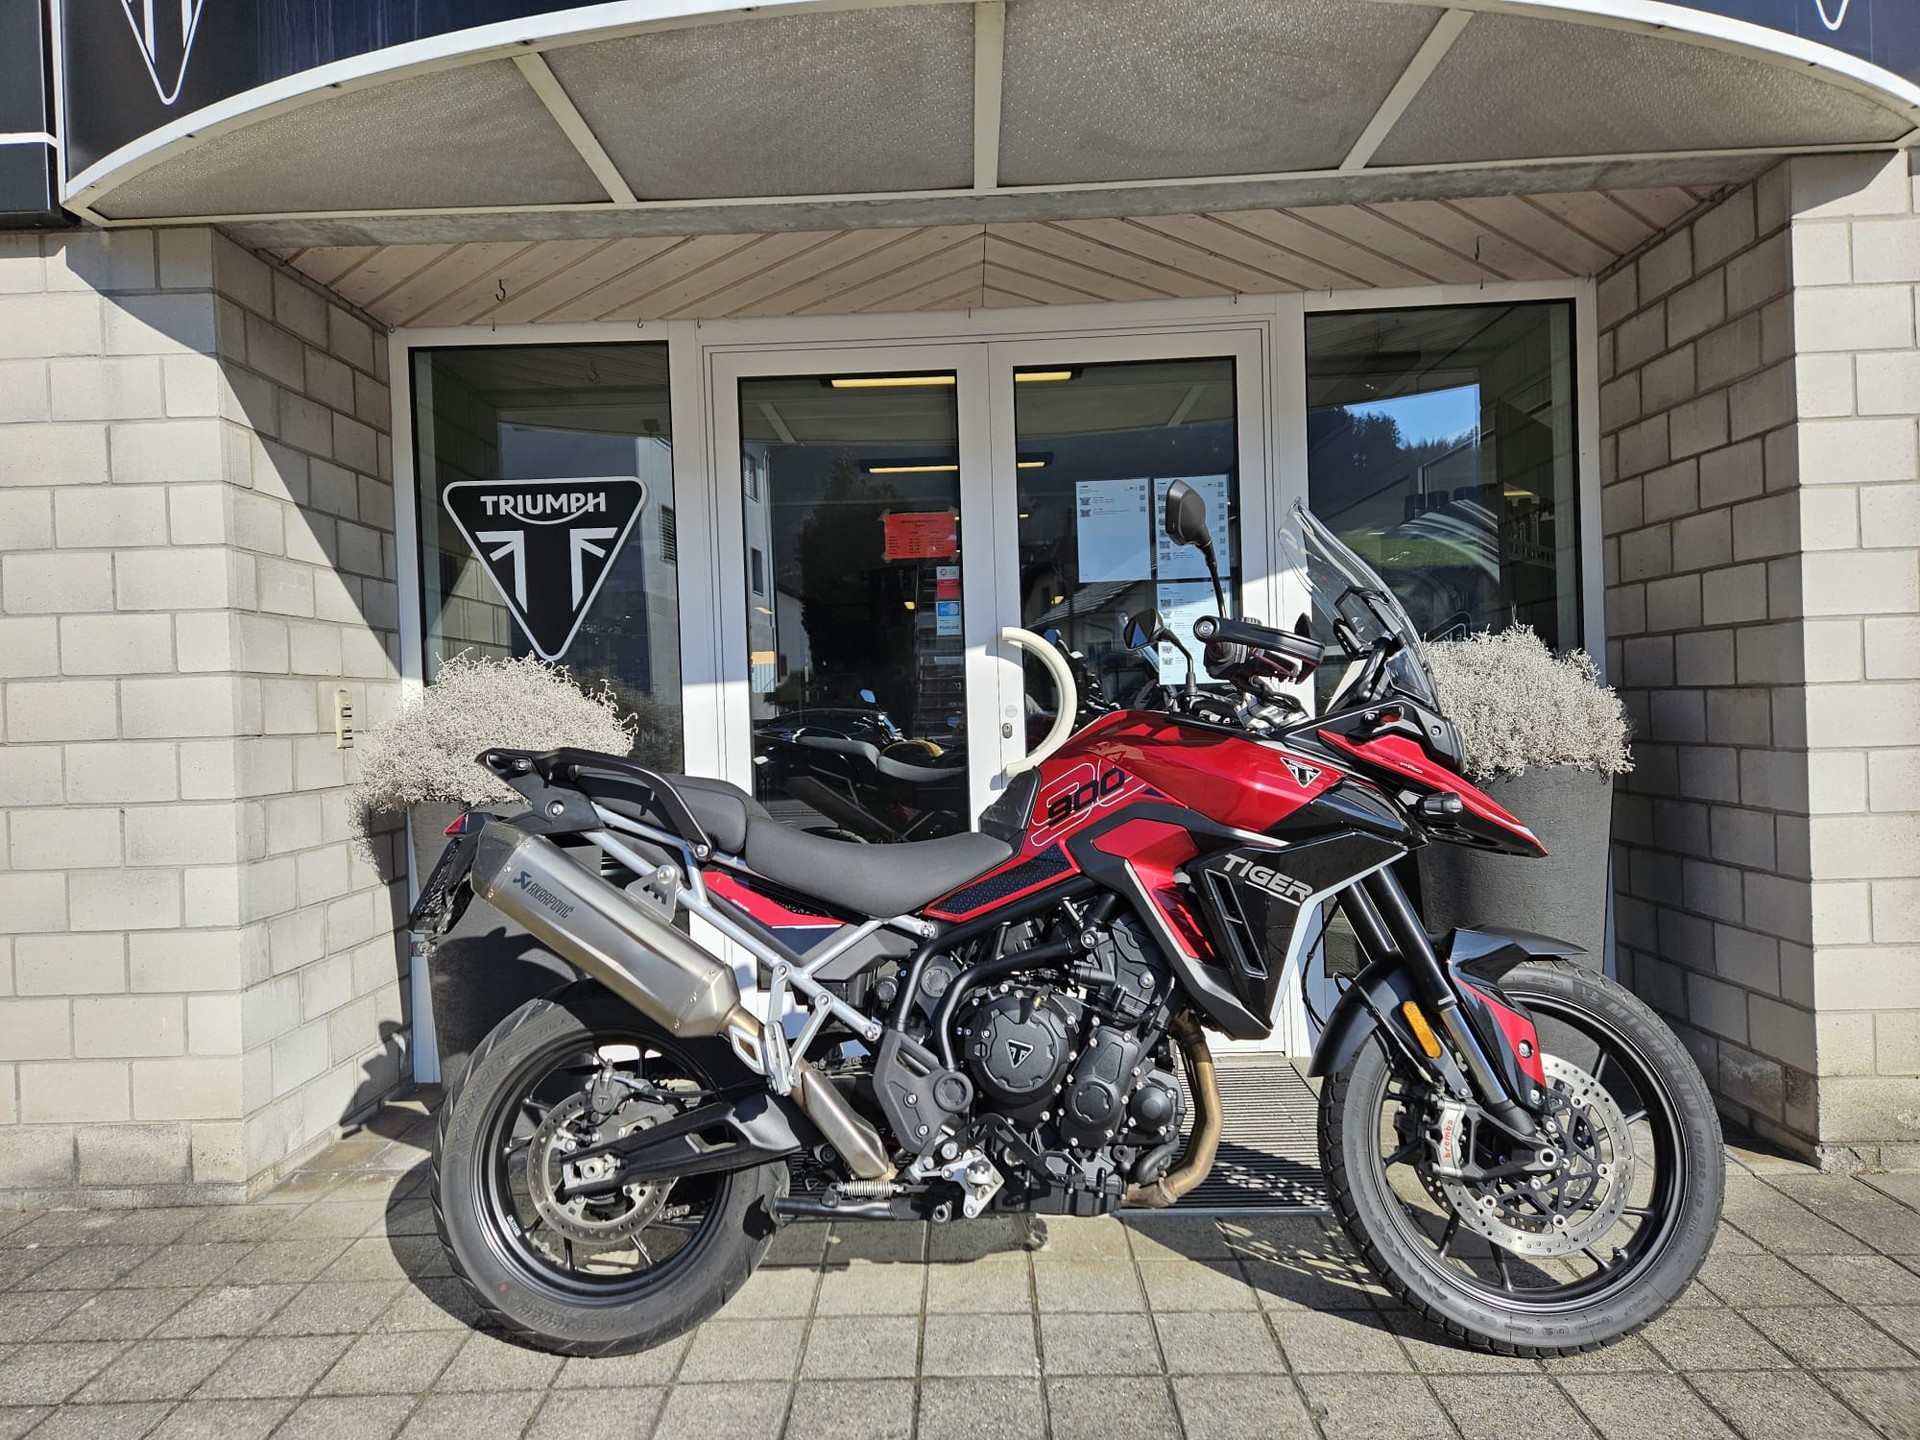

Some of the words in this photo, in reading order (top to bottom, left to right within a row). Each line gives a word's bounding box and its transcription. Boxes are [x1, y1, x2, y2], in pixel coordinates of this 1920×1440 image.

[480, 492, 606, 525] TRIUMPH
[1223, 853, 1314, 903] TIGER
[1606, 1001, 1703, 1110] MICHELIN
[1443, 1119, 1454, 1159] brembo
